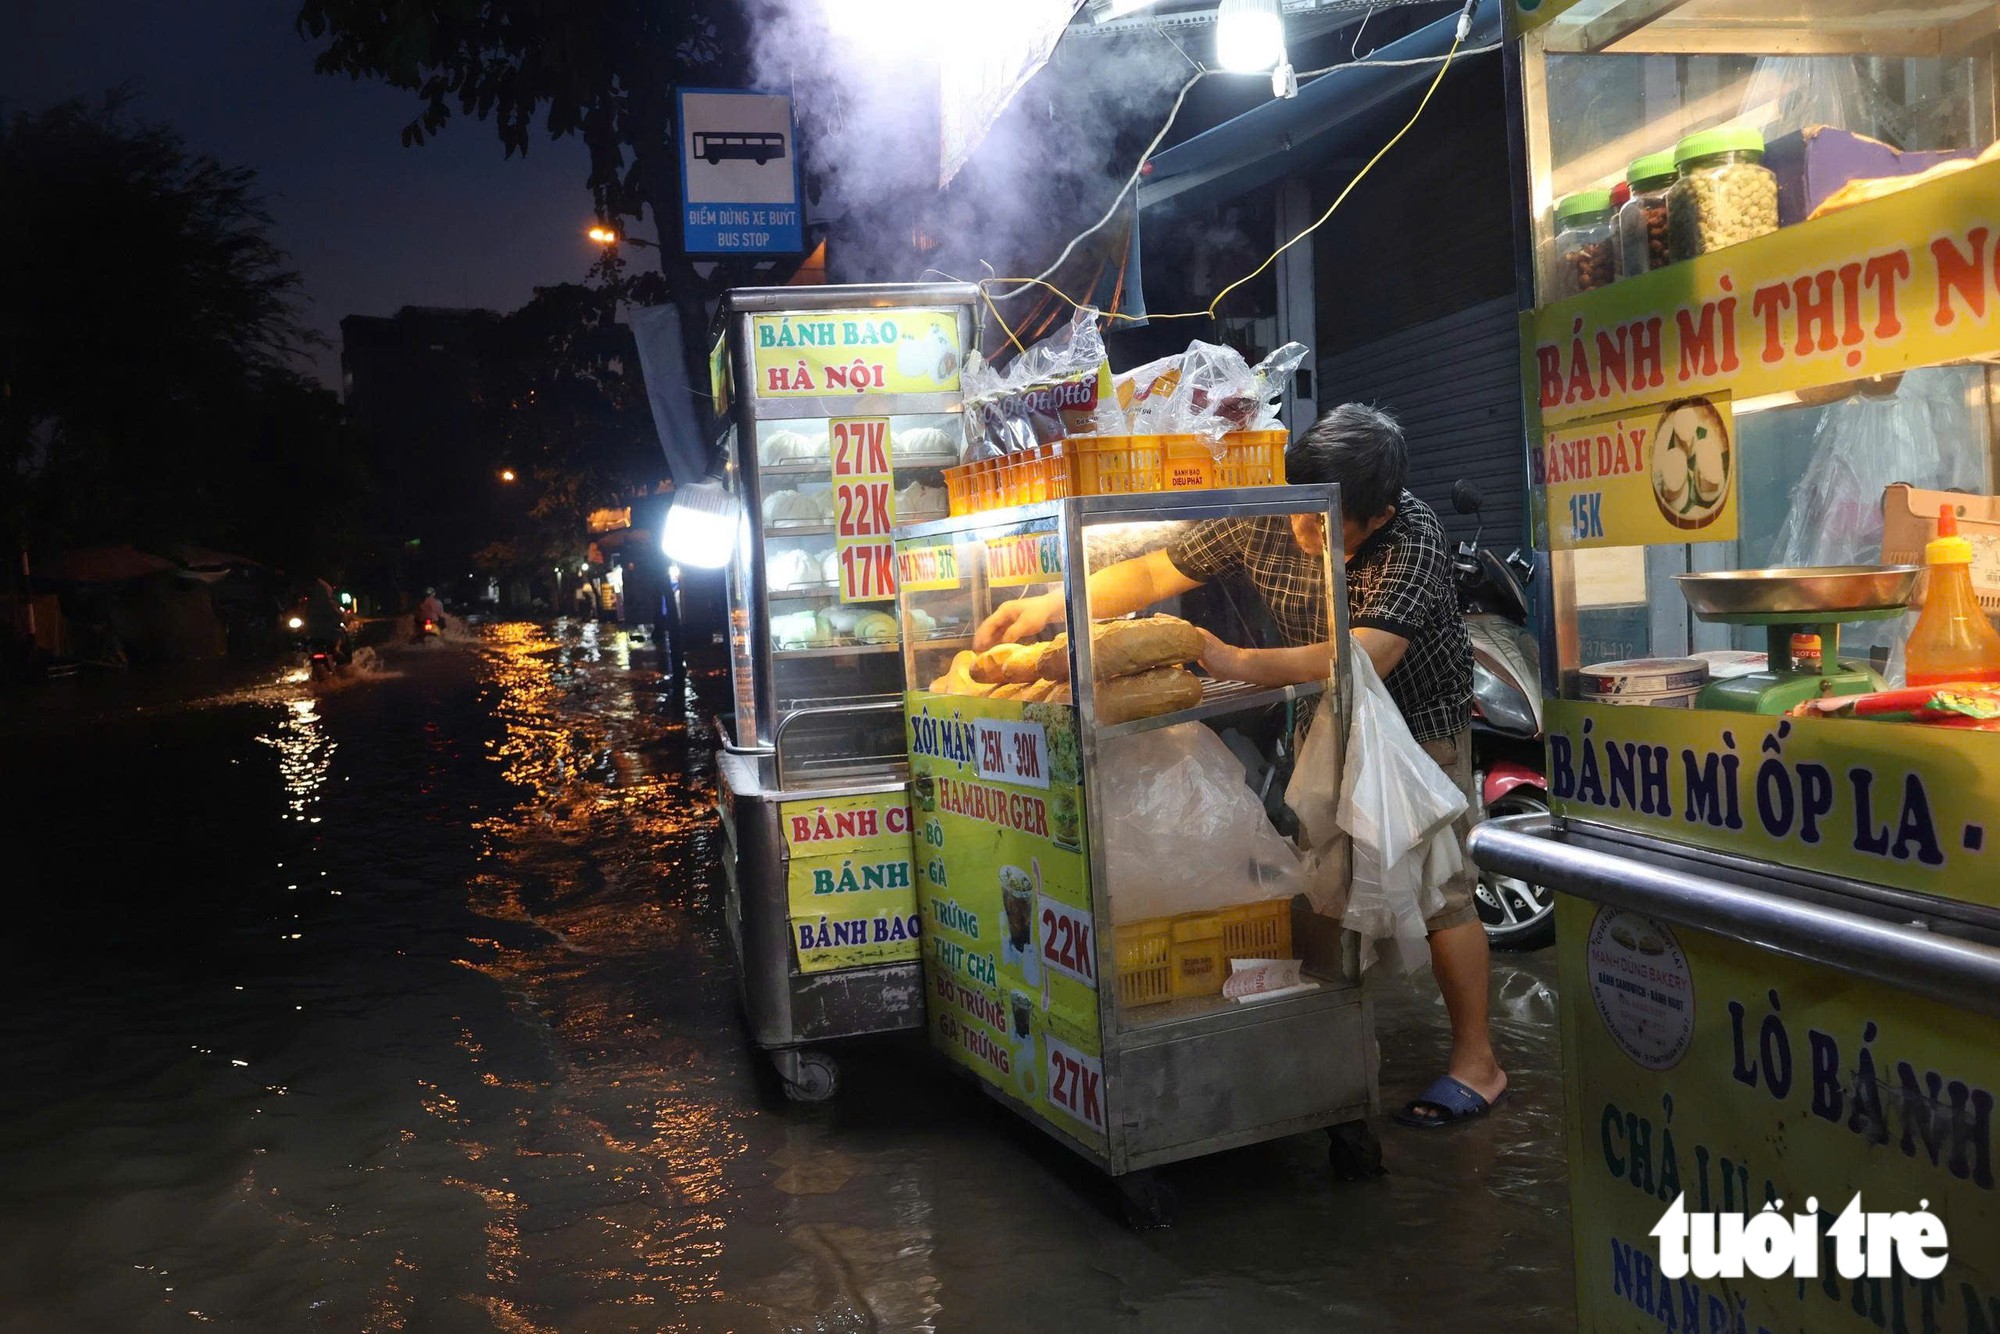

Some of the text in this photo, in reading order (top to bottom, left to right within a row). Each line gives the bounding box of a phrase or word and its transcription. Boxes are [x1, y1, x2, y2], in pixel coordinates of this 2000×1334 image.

[718, 232, 770, 247] BUS STOP
[752, 211, 766, 225] XE
[769, 208, 796, 225] BUÝT
[759, 318, 897, 348] BÁNH BAO
[1537, 227, 2000, 407] BÁNH MÌ THỊT N
[768, 359, 885, 393] HÀ NỘI
[1053, 384, 1091, 409] Otto
[834, 422, 889, 476] 27K
[1532, 434, 1592, 485] BÁNH
[838, 483, 891, 537] 22K
[1569, 492, 1604, 539] 15K
[842, 545, 895, 598] 17K
[1040, 536, 1061, 574] 6K
[911, 706, 975, 770] XÔI MẶN
[980, 729, 1005, 773] 25K
[1013, 731, 1040, 778] 30K
[939, 776, 1049, 838] HAMBURGER
[1549, 718, 1944, 865] BÁNH MÌ ỐP LA
[791, 806, 878, 843] BÁNH
[926, 820, 944, 848] BÒ
[813, 860, 909, 895] BÁNH
[929, 857, 947, 888] GÀ
[799, 915, 920, 949] BÁNH BAO
[931, 900, 979, 939] TRỨNG
[1043, 908, 1092, 979] 22K
[933, 936, 996, 988] THỊT CHẢ
[937, 971, 1006, 1033] BÒ TRỨNG
[961, 1030, 1010, 1074] TRỨNG
[1052, 1051, 1101, 1126] 27K
[1728, 989, 1994, 1190] LÒ BÁNH
[1602, 1093, 1681, 1203] CHẢ
